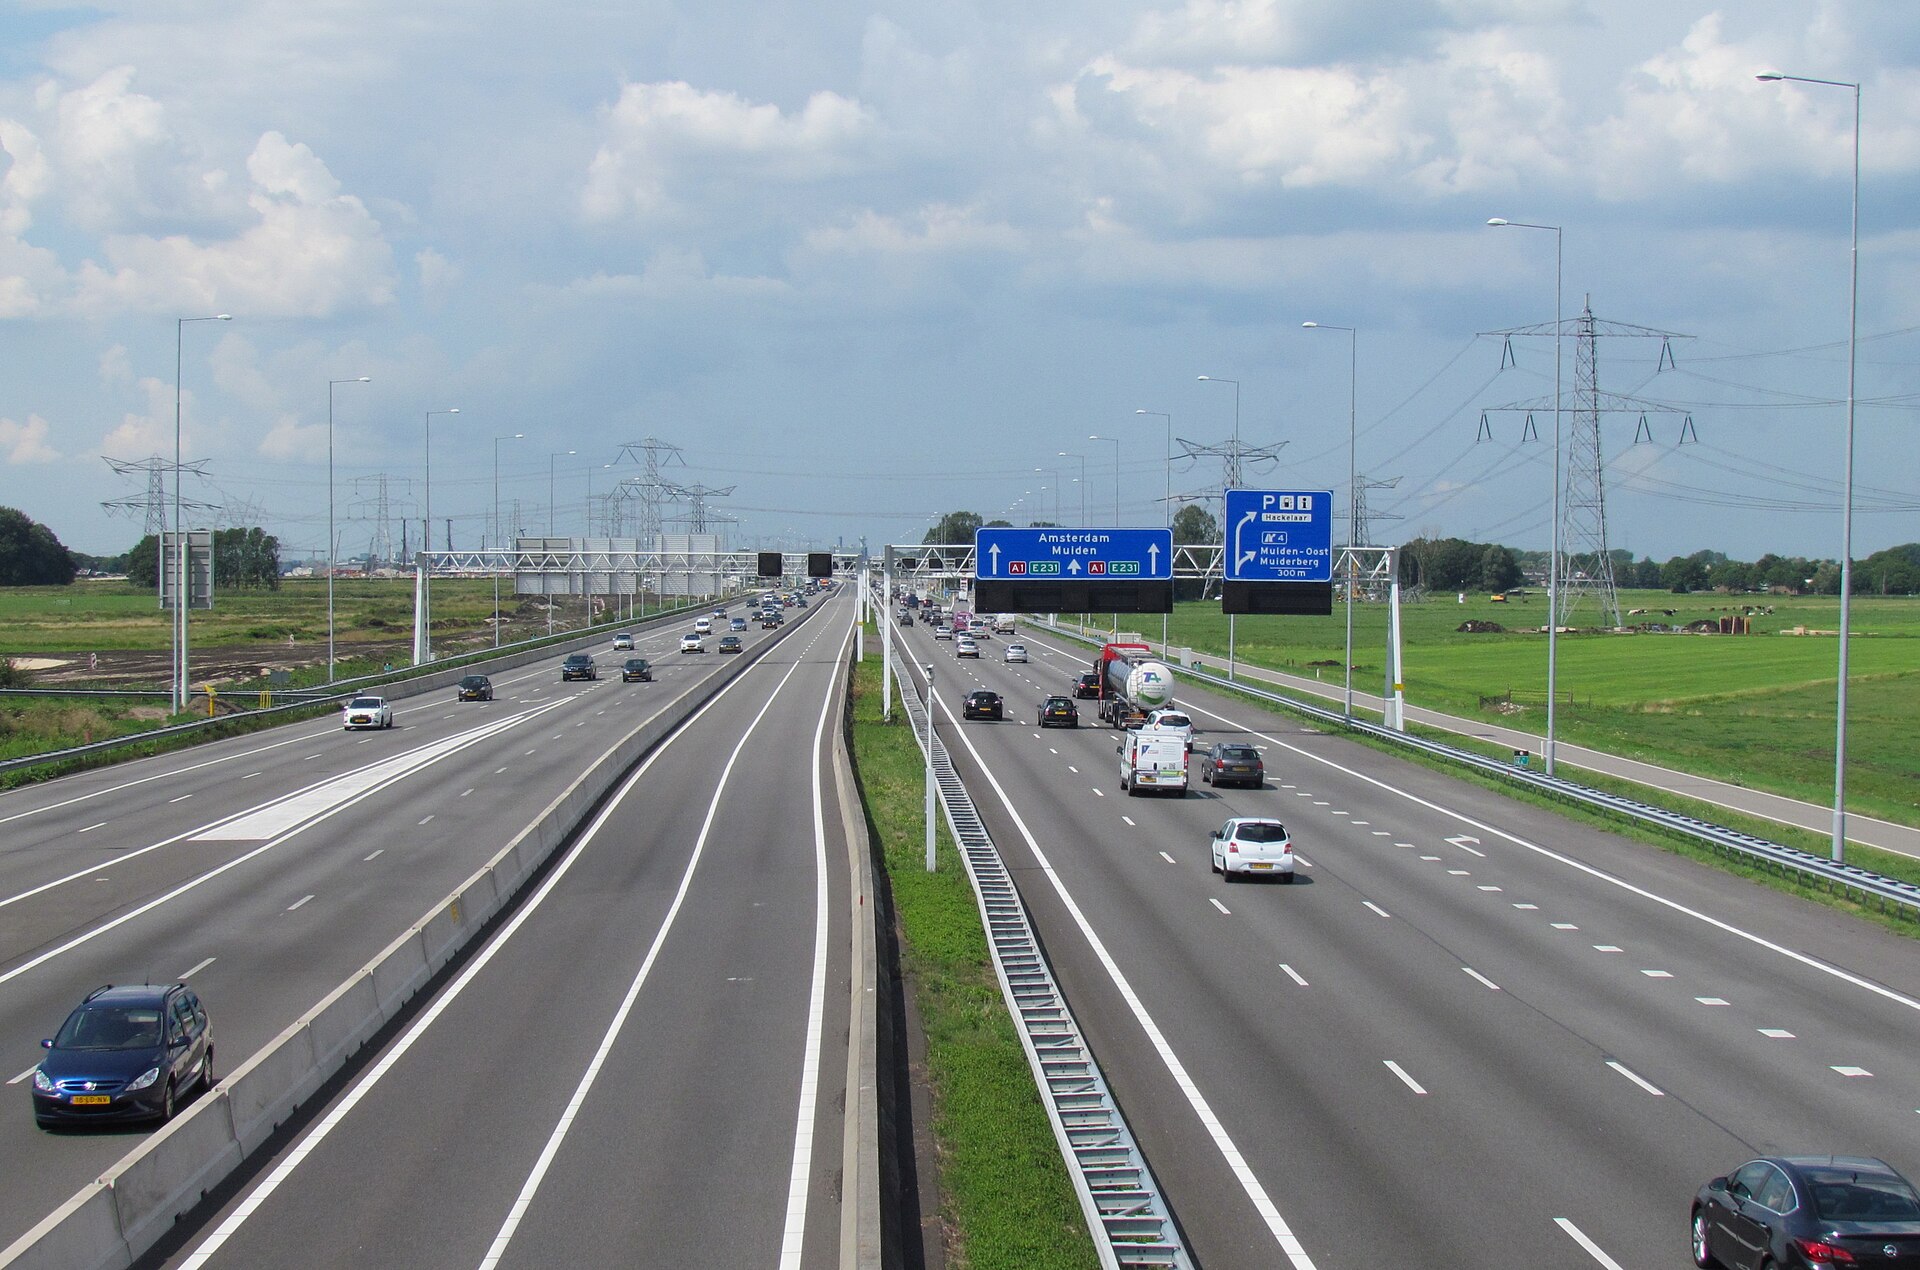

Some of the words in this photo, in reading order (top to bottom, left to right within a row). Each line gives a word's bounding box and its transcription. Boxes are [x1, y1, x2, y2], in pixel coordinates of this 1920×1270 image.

[1038, 533, 1110, 543] Amsterdam
[1277, 534, 1284, 542] 4
[1052, 546, 1097, 555] Muiden
[1260, 547, 1329, 556] Muiden-Oost
[1260, 558, 1319, 568] Muiderberg
[1011, 564, 1024, 572] A1
[1090, 564, 1104, 572] A1
[1277, 569, 1295, 577] 300
[1143, 672, 1162, 683] TA
